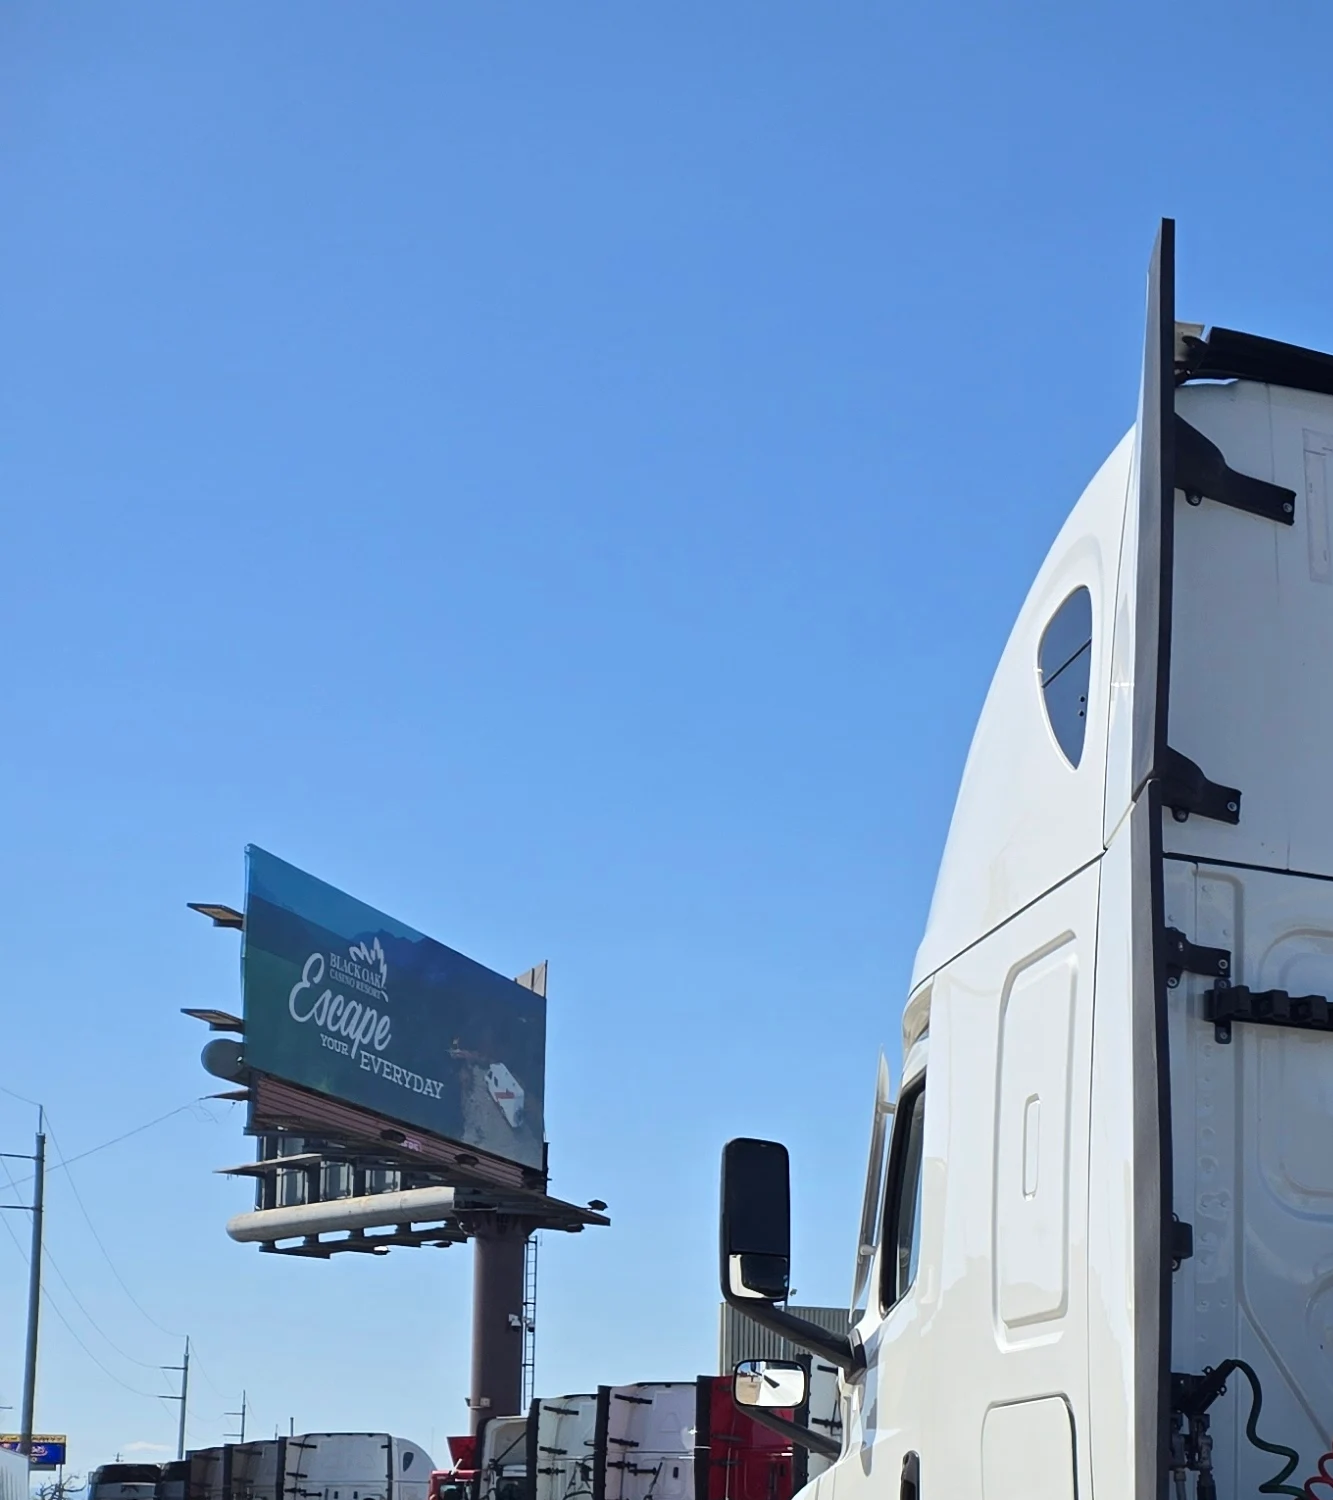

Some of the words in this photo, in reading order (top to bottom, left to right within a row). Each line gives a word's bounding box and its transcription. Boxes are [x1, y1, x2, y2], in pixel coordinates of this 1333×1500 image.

[330, 953, 361, 979] BLACK
[361, 968, 381, 989] OAK
[289, 953, 391, 1059] Escape
[320, 1033, 349, 1056] YOUR
[360, 1050, 444, 1099] EVERYDAY
